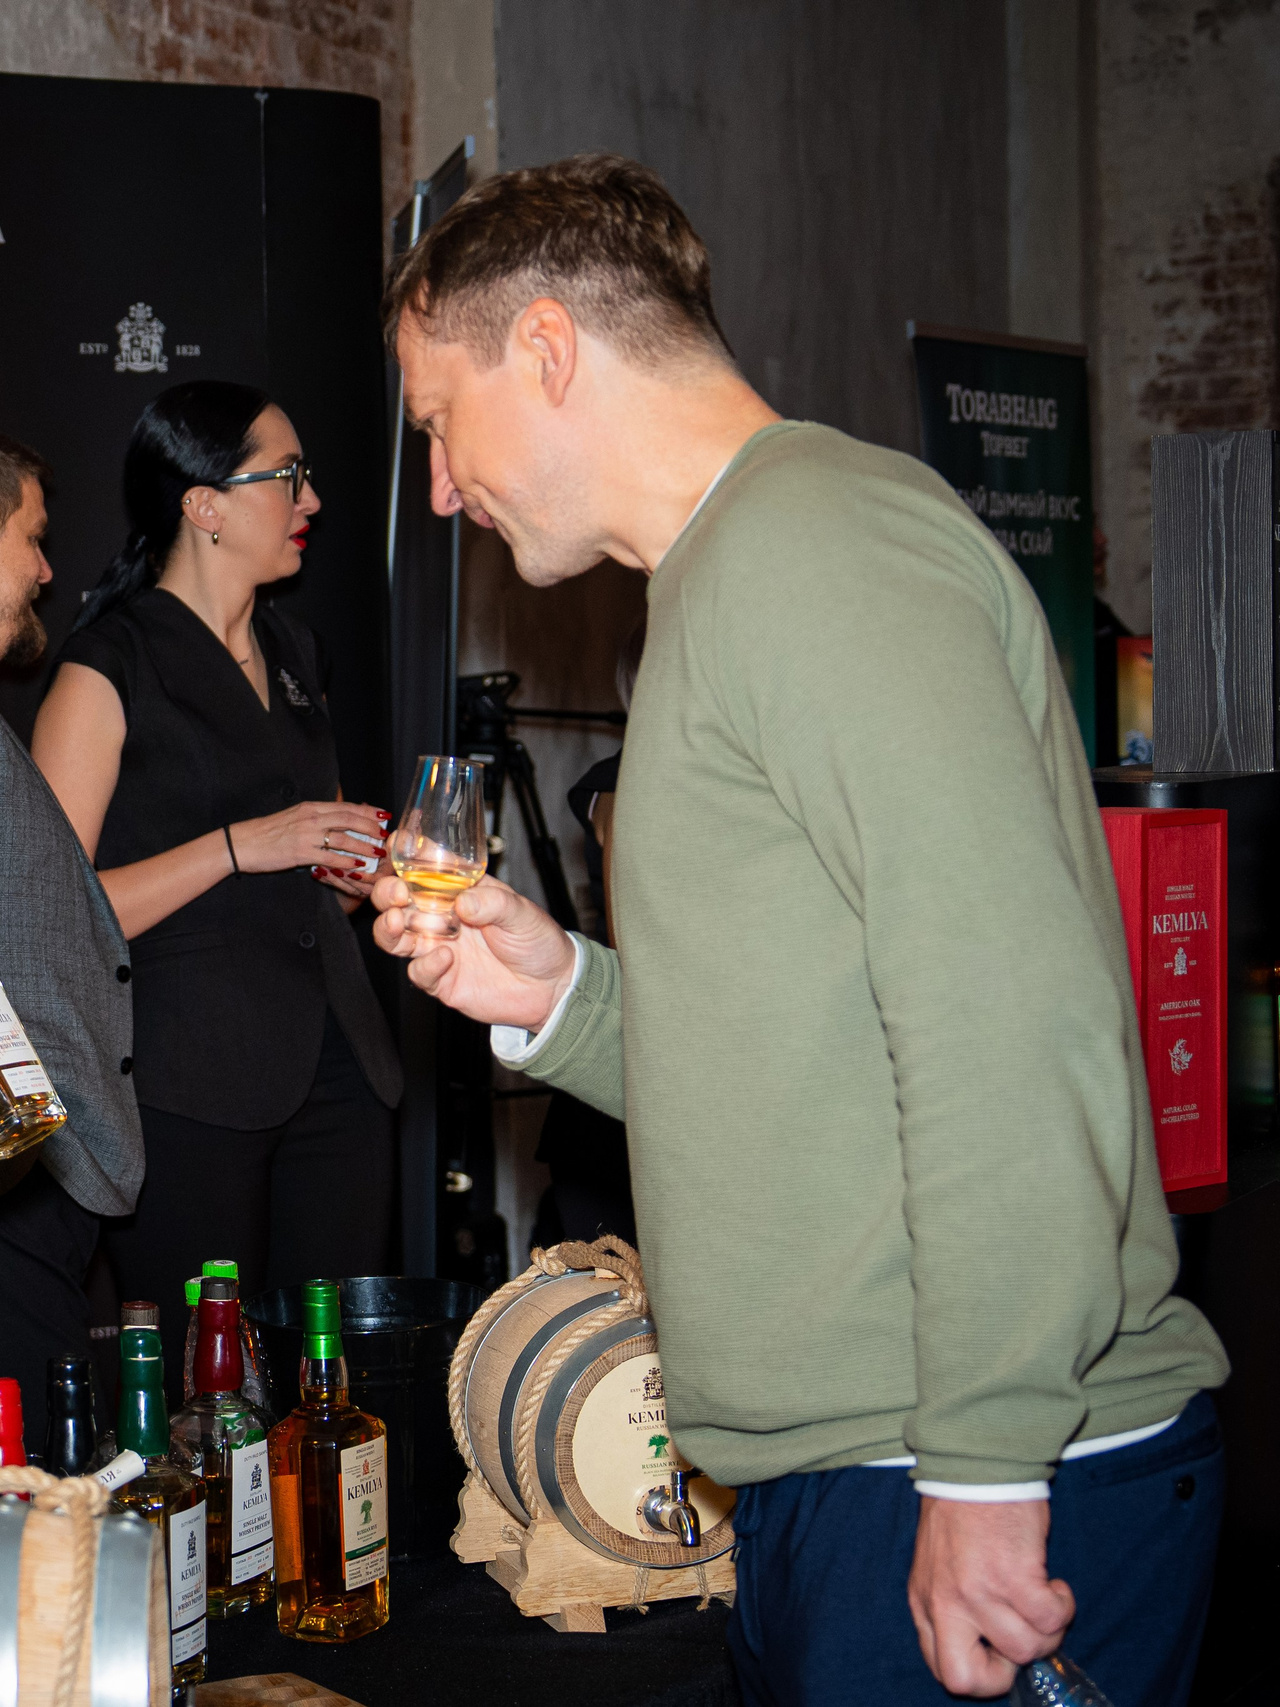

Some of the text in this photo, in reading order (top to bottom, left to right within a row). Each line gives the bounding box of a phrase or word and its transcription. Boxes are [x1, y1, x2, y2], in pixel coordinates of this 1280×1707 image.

[945, 383, 1058, 429] TORABHAIG
[1048, 495, 1081, 521] ВКУС
[1152, 911, 1209, 935] KEMLYA
[1160, 998, 1201, 1011] AMERICAN OAK
[641, 1462, 667, 1470] RUSSIAN
[347, 1476, 383, 1501] KEMLYA
[243, 1493, 268, 1510] KEMLYA
[238, 1519, 270, 1538] WHISKY PREVIEW
[242, 1513, 267, 1529] SINGLE MALT
[181, 1563, 202, 1581] KEMLYA
